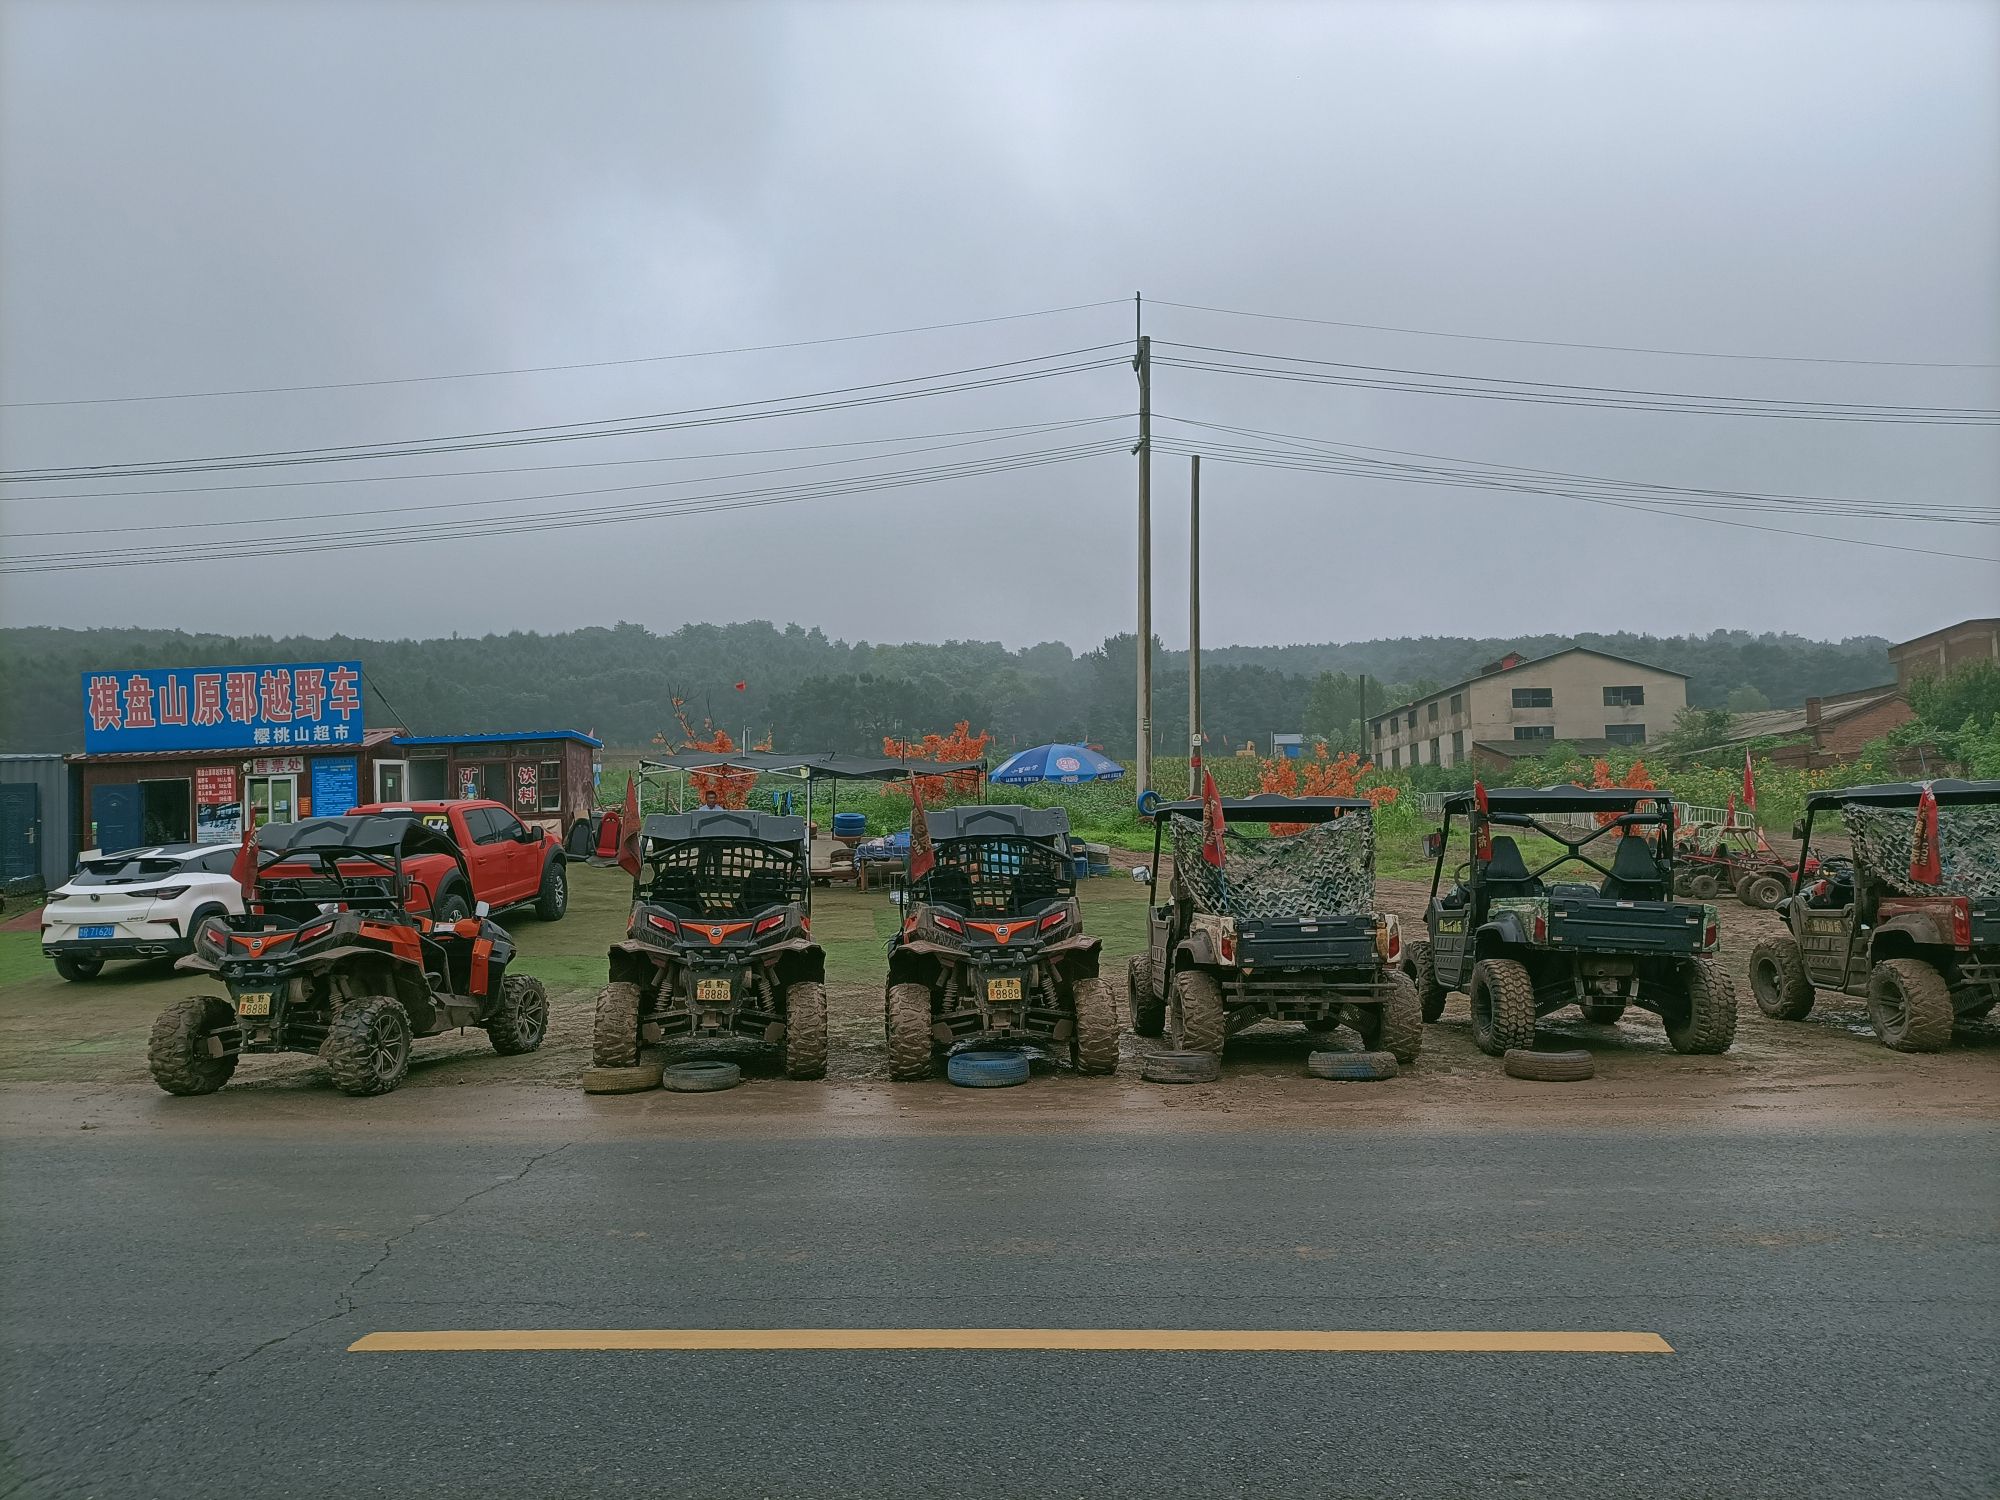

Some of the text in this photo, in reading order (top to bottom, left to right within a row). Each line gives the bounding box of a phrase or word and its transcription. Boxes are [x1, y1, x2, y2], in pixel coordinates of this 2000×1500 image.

[88, 665, 361, 732] 棋盘山原郡越野车
[253, 724, 350, 745] 樱桃山超市
[255, 757, 302, 773] 售票处
[518, 767, 537, 805] 饮料
